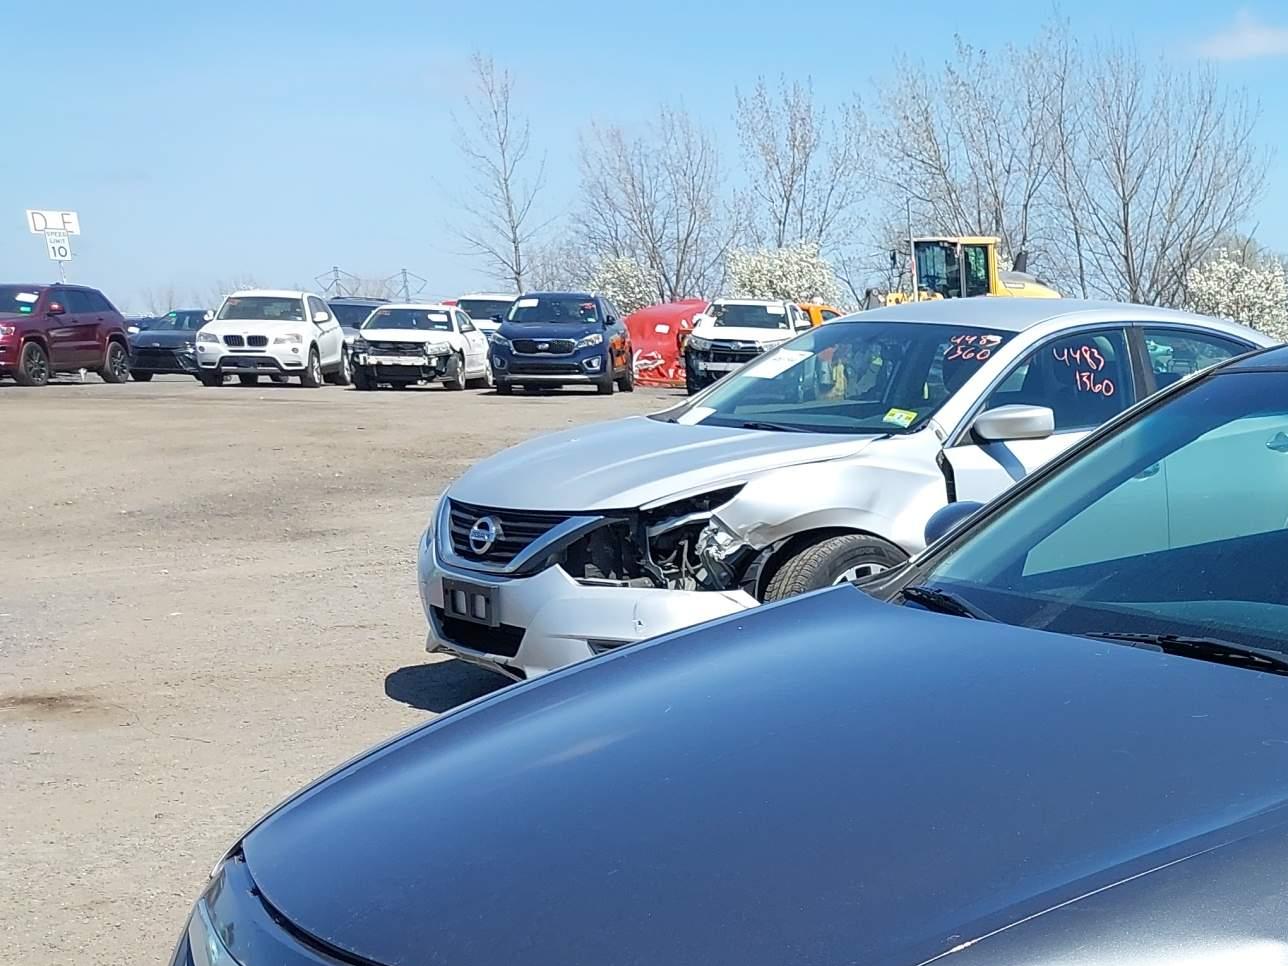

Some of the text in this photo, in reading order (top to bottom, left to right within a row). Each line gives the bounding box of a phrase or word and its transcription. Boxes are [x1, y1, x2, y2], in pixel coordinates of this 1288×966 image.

[31, 212, 48, 231] D
[51, 246, 68, 258] 10
[1052, 345, 1105, 372] 4483
